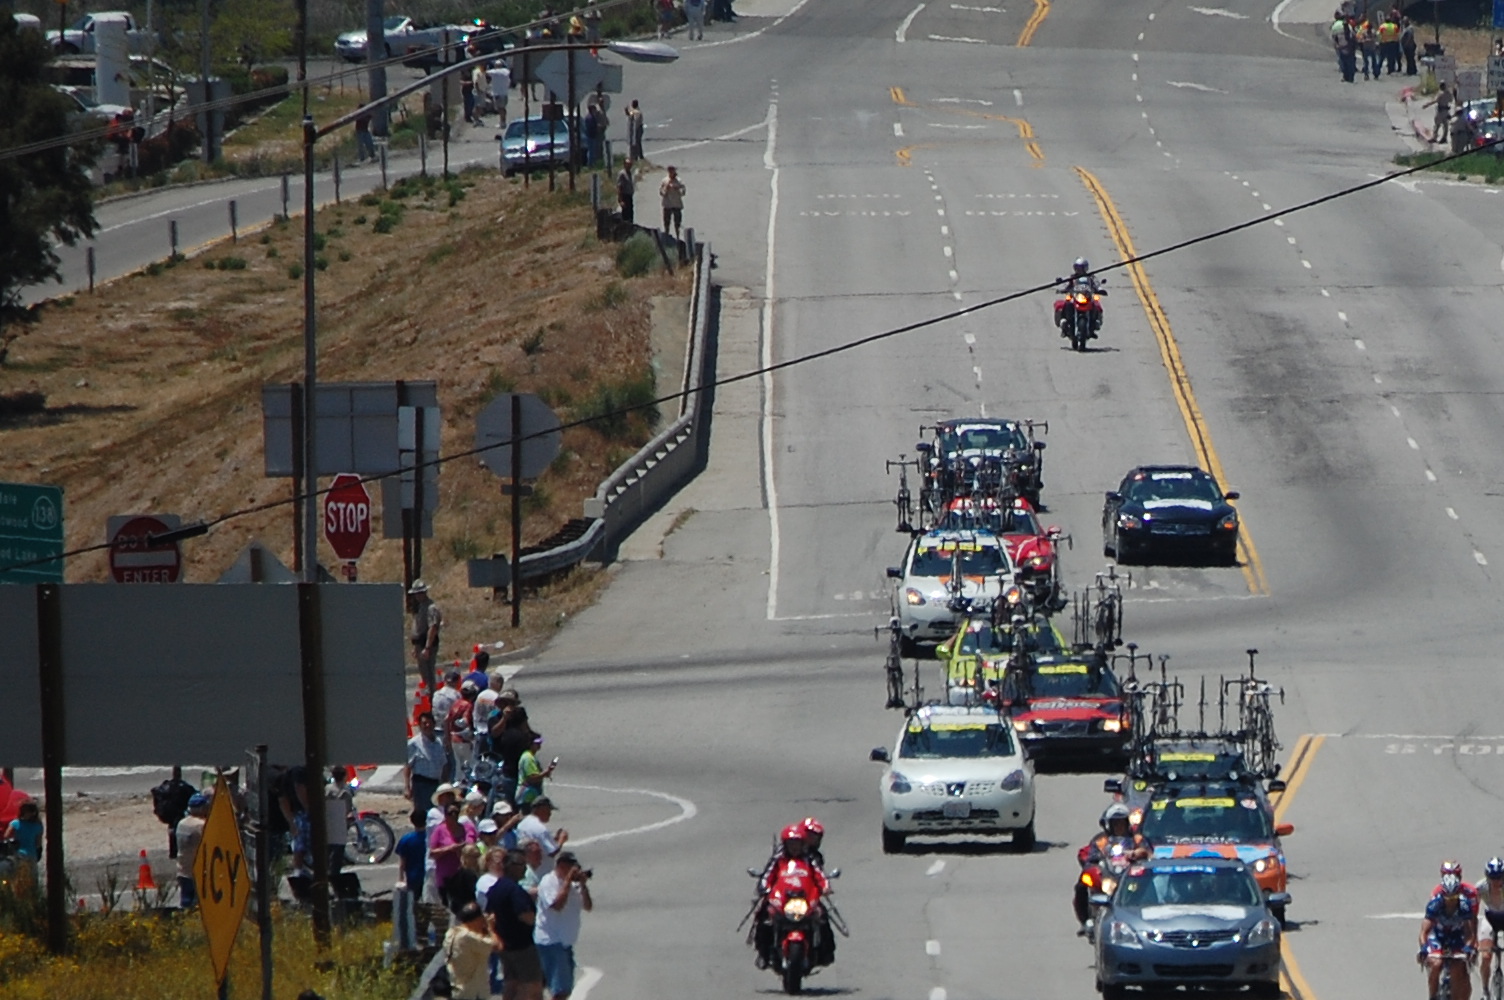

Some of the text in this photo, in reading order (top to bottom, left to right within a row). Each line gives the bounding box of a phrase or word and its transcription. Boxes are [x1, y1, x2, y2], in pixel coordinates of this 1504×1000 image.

[35, 505, 54, 523] 138
[327, 501, 368, 534] STOP
[123, 569, 171, 585] ENTER
[202, 843, 241, 907] ICY
